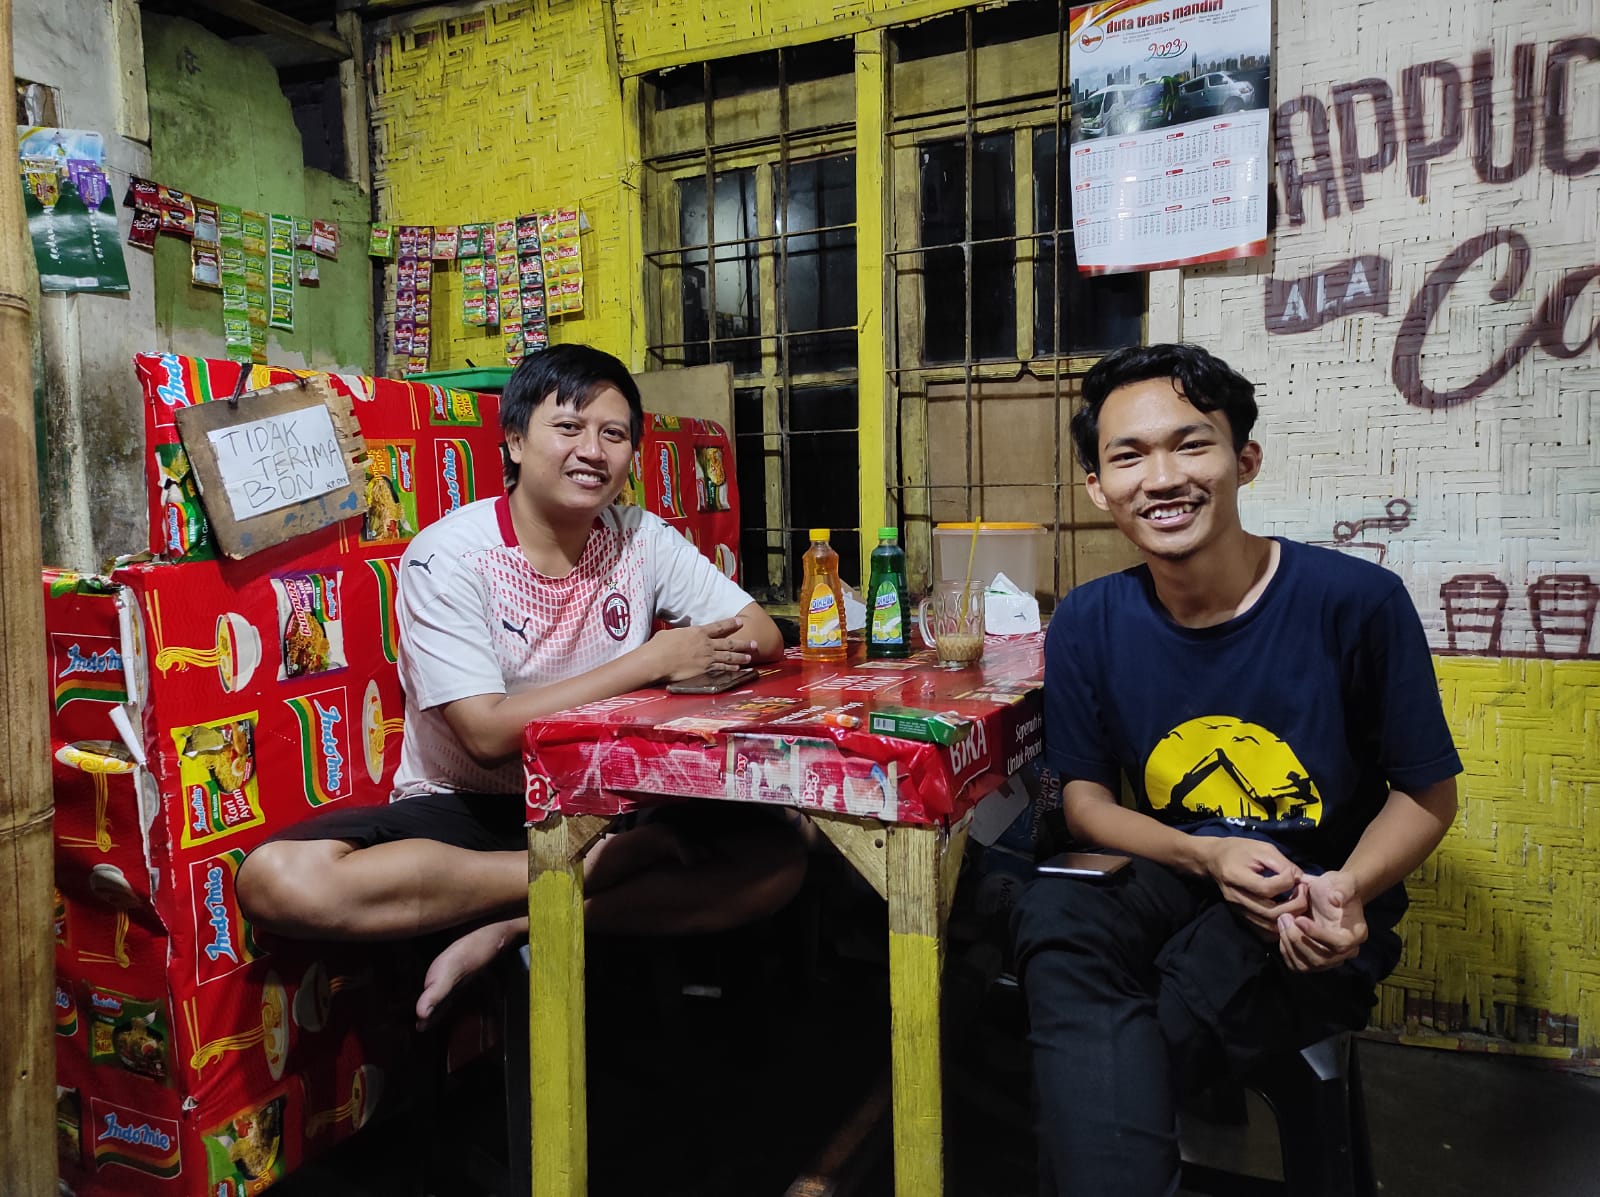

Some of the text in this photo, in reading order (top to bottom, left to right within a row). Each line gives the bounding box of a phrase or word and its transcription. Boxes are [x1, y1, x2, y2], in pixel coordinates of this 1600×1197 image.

[1106, 18, 1134, 34] duta
[1137, 11, 1170, 28] trans
[1172, 0, 1224, 20] mandiri
[1144, 38, 1188, 62] 2023
[1281, 259, 1375, 323] ALA
[220, 420, 300, 457] TIDAK
[253, 438, 342, 481] TERIMA
[242, 471, 313, 509] BON
[284, 578, 312, 637] Rendang
[58, 643, 124, 679] Indom
[313, 698, 342, 791] Indomie
[225, 799, 240, 823] Kari
[233, 788, 250, 818] Ayam
[204, 866, 239, 964] Indomie
[98, 1112, 171, 1151] Indomie
